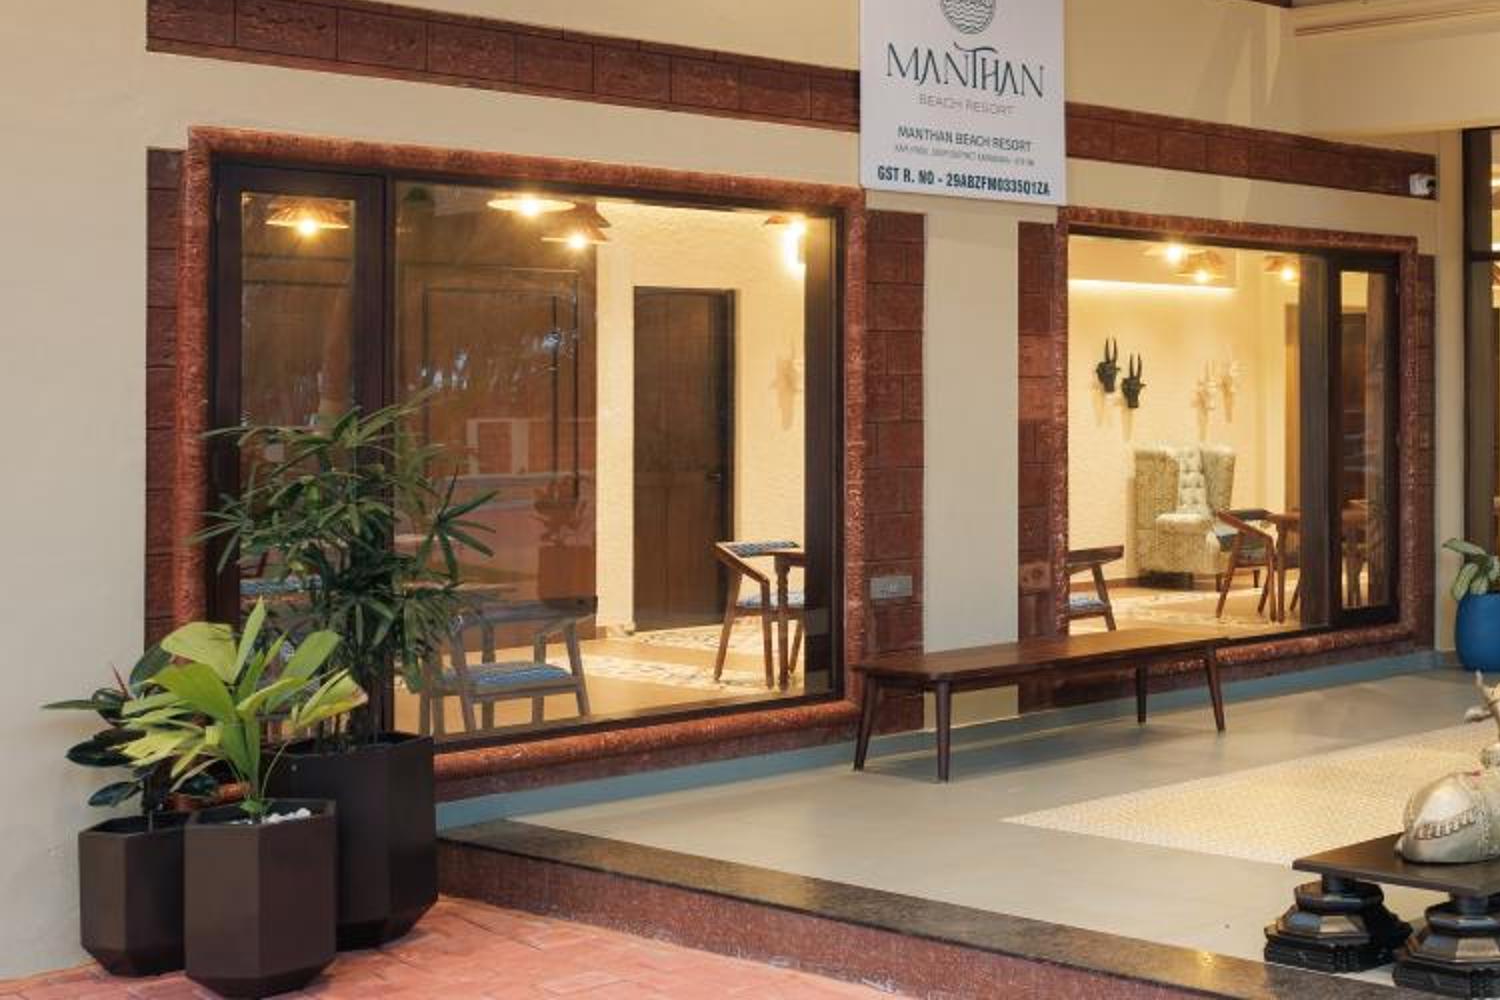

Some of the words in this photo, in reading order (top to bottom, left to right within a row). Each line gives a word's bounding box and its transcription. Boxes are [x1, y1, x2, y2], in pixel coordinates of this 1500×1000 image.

[885, 41, 1044, 97] MANTHAN
[919, 93, 962, 111] BEACH
[965, 98, 1015, 115] RESORT
[897, 126, 953, 144] MANTHAN
[955, 132, 991, 147] BEACH
[992, 137, 1032, 152] RESORT
[877, 165, 899, 181] GST
[903, 168, 915, 183] R.
[918, 170, 935, 185] NO
